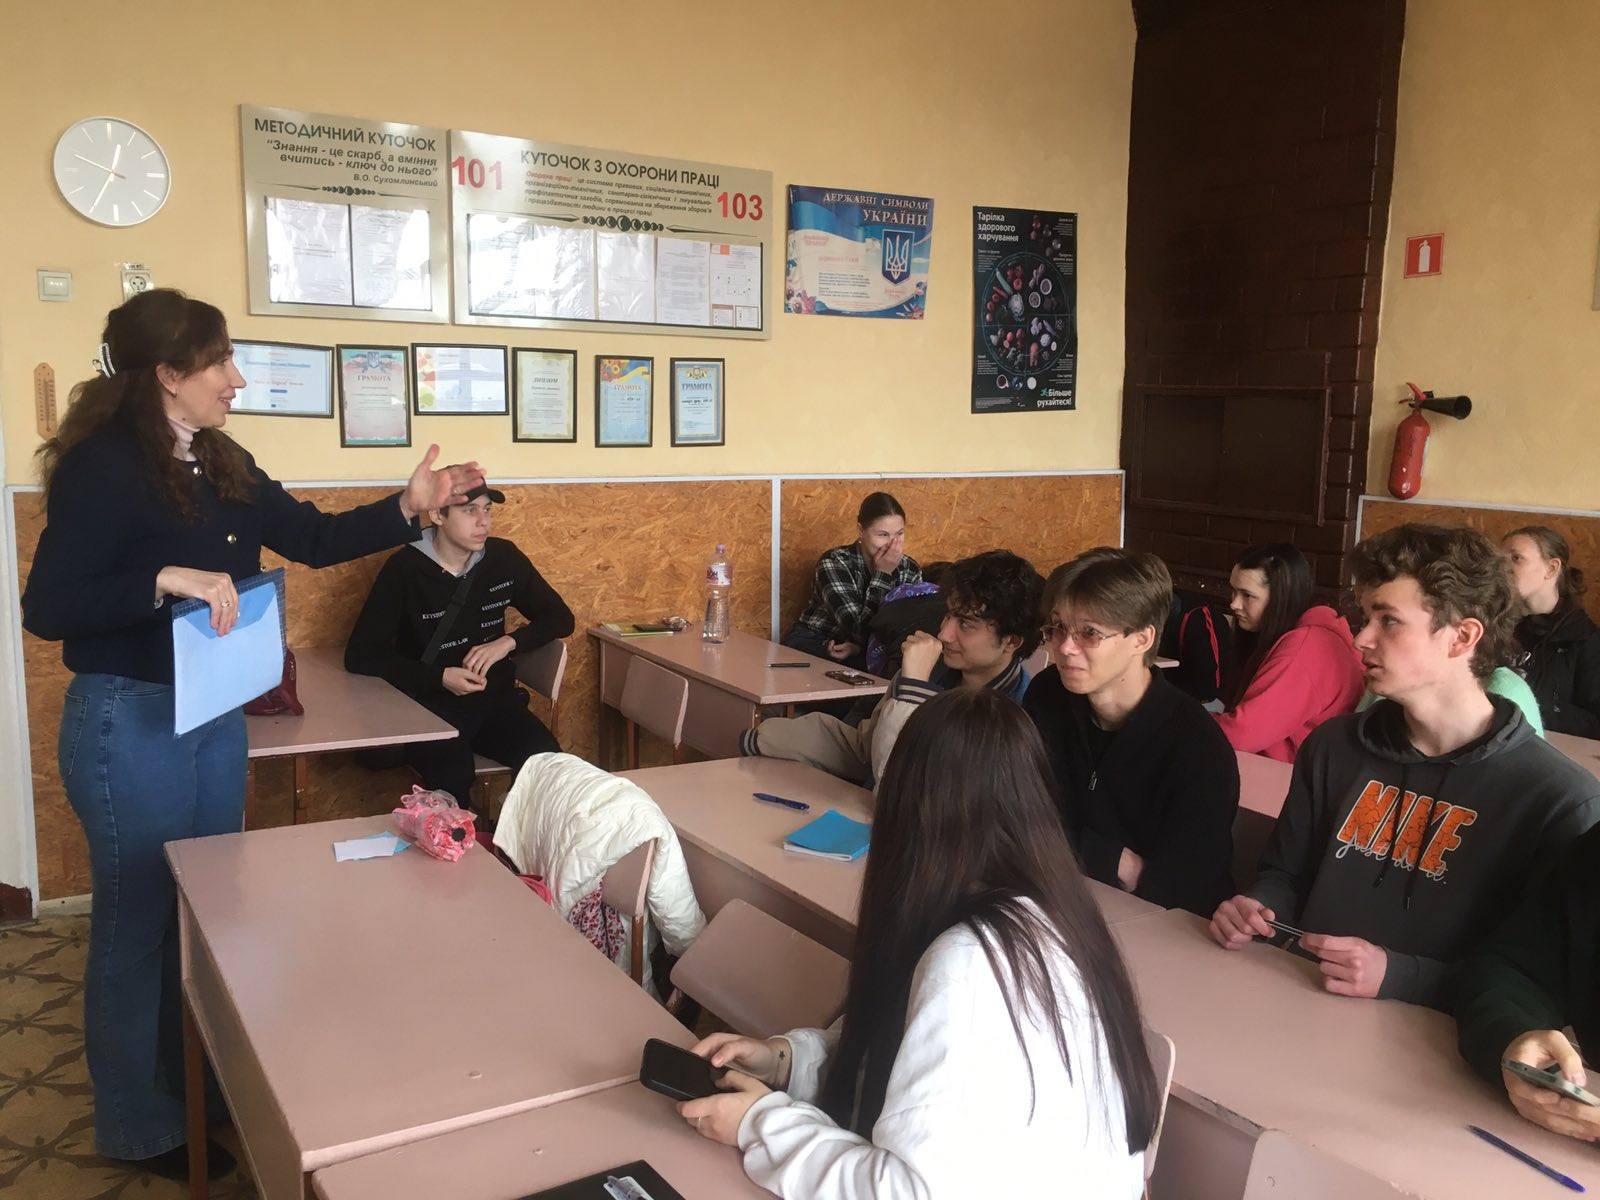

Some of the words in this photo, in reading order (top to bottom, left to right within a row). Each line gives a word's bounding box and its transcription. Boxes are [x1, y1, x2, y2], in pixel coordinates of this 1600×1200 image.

[254, 118, 364, 143] МЕТОДИЧНИЙ
[368, 132, 436, 151] КУТОЧОК
[280, 154, 335, 167] вчитись
[346, 161, 377, 171] ключ
[380, 160, 394, 172] до
[329, 148, 344, 157] це
[388, 154, 394, 162] а
[398, 155, 437, 166] вміння
[449, 155, 502, 190] 101
[521, 150, 590, 171] КУТОЧОК
[606, 161, 677, 182] ОХОРОНИ
[681, 171, 719, 189] ПРАЦІ
[717, 191, 763, 221] 103
[823, 192, 877, 205] ДЕРЖАВНІ
[881, 197, 929, 210] СИМВОЛИ
[863, 209, 928, 226] УКРАЇНИ
[977, 212, 1005, 222] Тарілка
[977, 223, 1016, 233] здорового
[977, 233, 1019, 243] харчування
[681, 382, 713, 391] ГРАМОТА
[1048, 388, 1072, 397] Більше
[1037, 398, 1072, 408] рухайтеся!
[1336, 779, 1478, 876] NIKE
